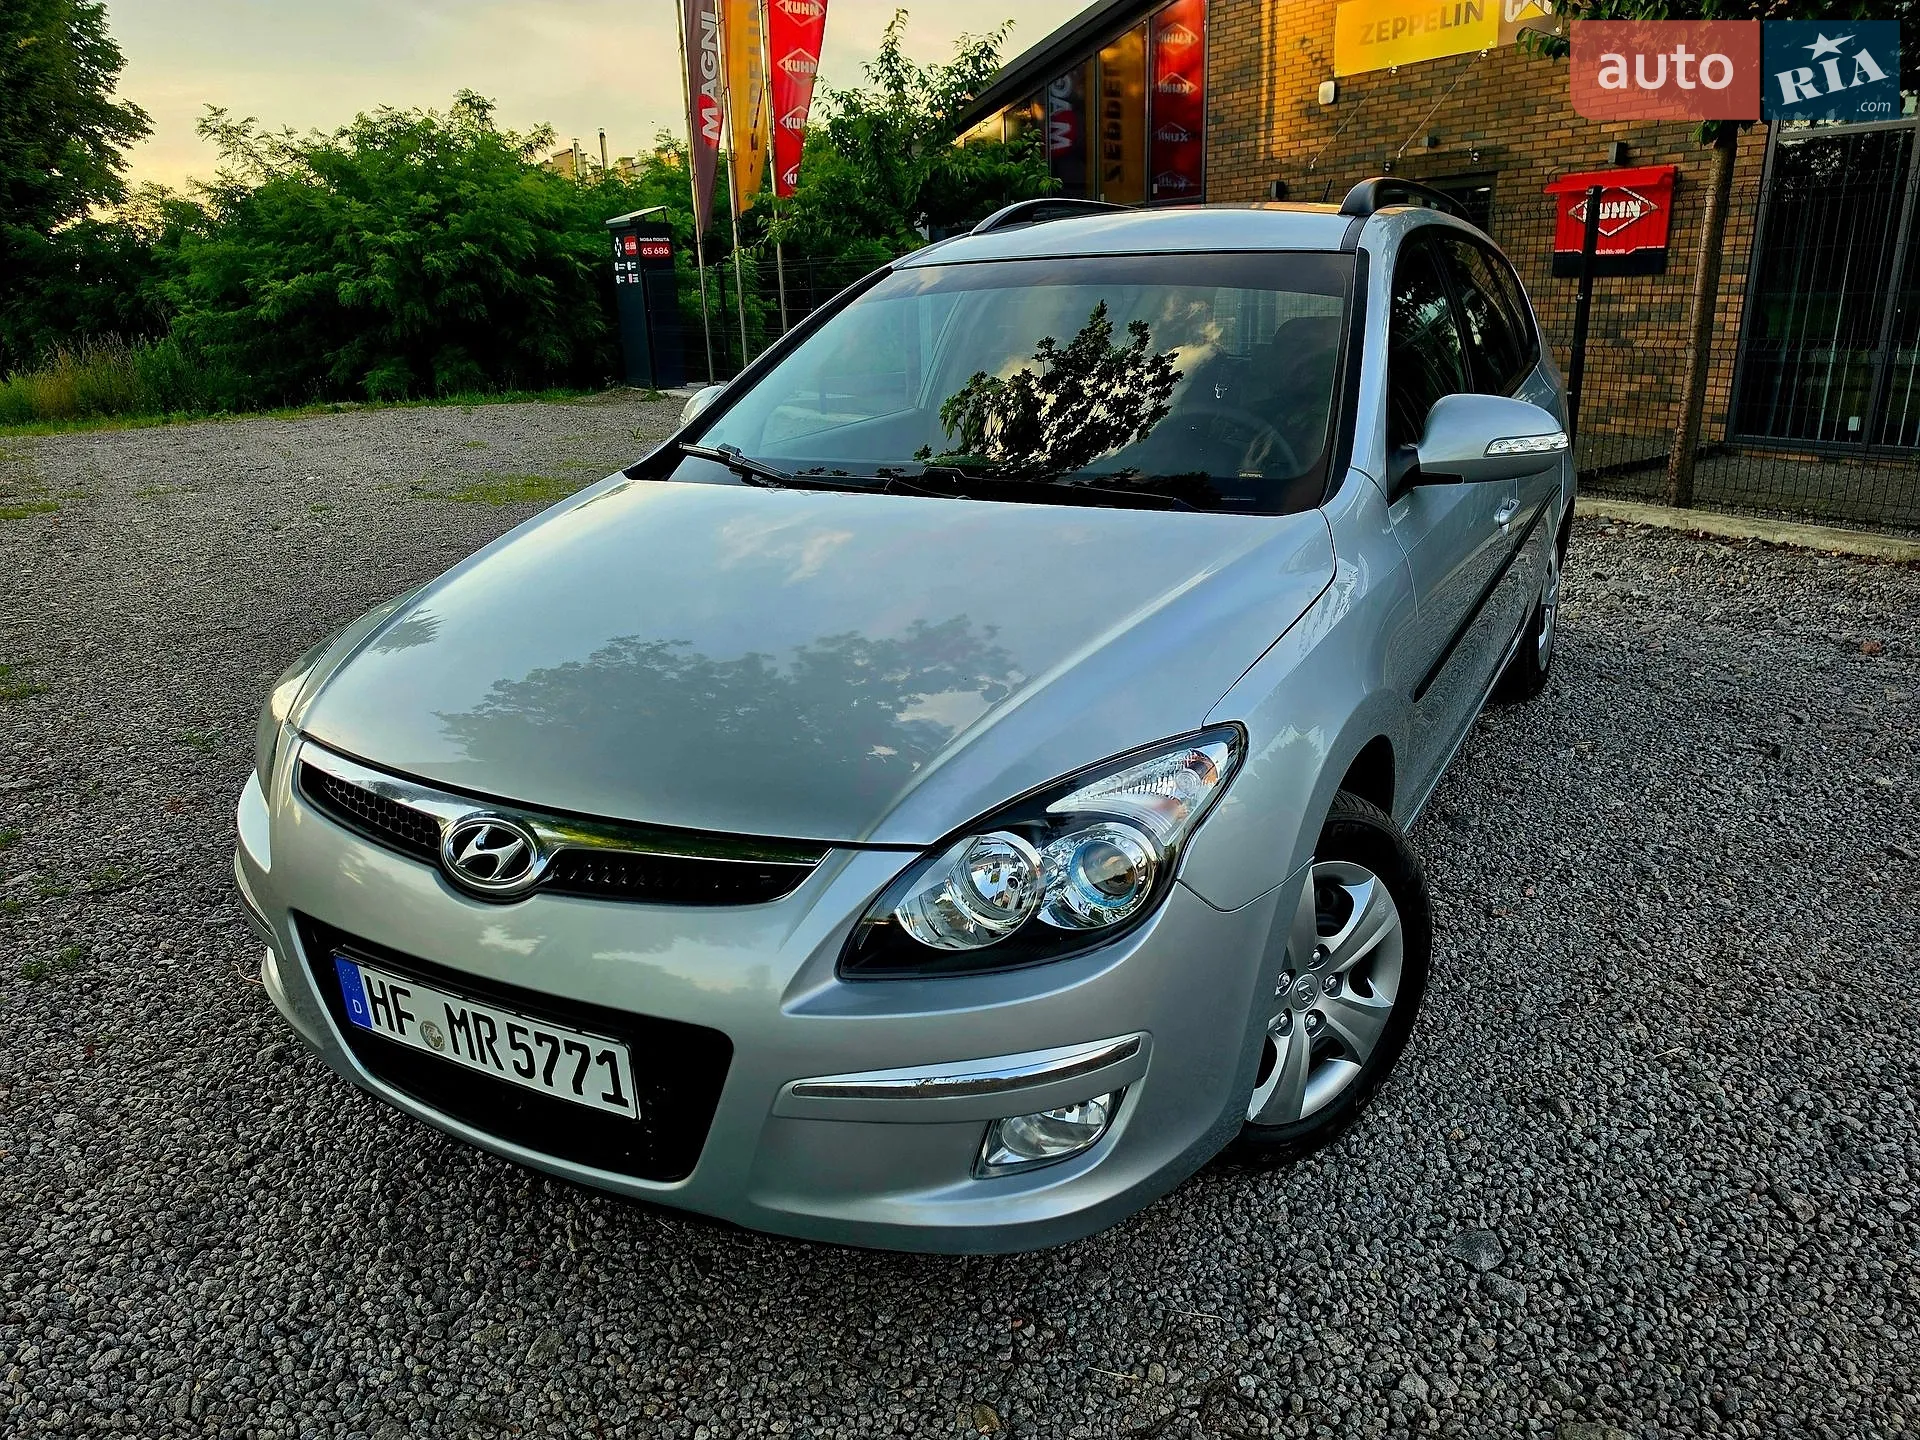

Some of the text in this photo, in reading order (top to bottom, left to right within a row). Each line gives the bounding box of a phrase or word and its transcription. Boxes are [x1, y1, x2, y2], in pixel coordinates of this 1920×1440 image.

[784, 0, 820, 16] KUHN
[1359, 0, 1485, 46] ZEPPELIN
[701, 10, 718, 141] MAGNI
[784, 59, 818, 73] KUHN
[1582, 200, 1641, 222] UHN
[642, 247, 669, 255] 65 686
[352, 998, 363, 1014] D
[363, 973, 630, 1109] HF MR 5771
